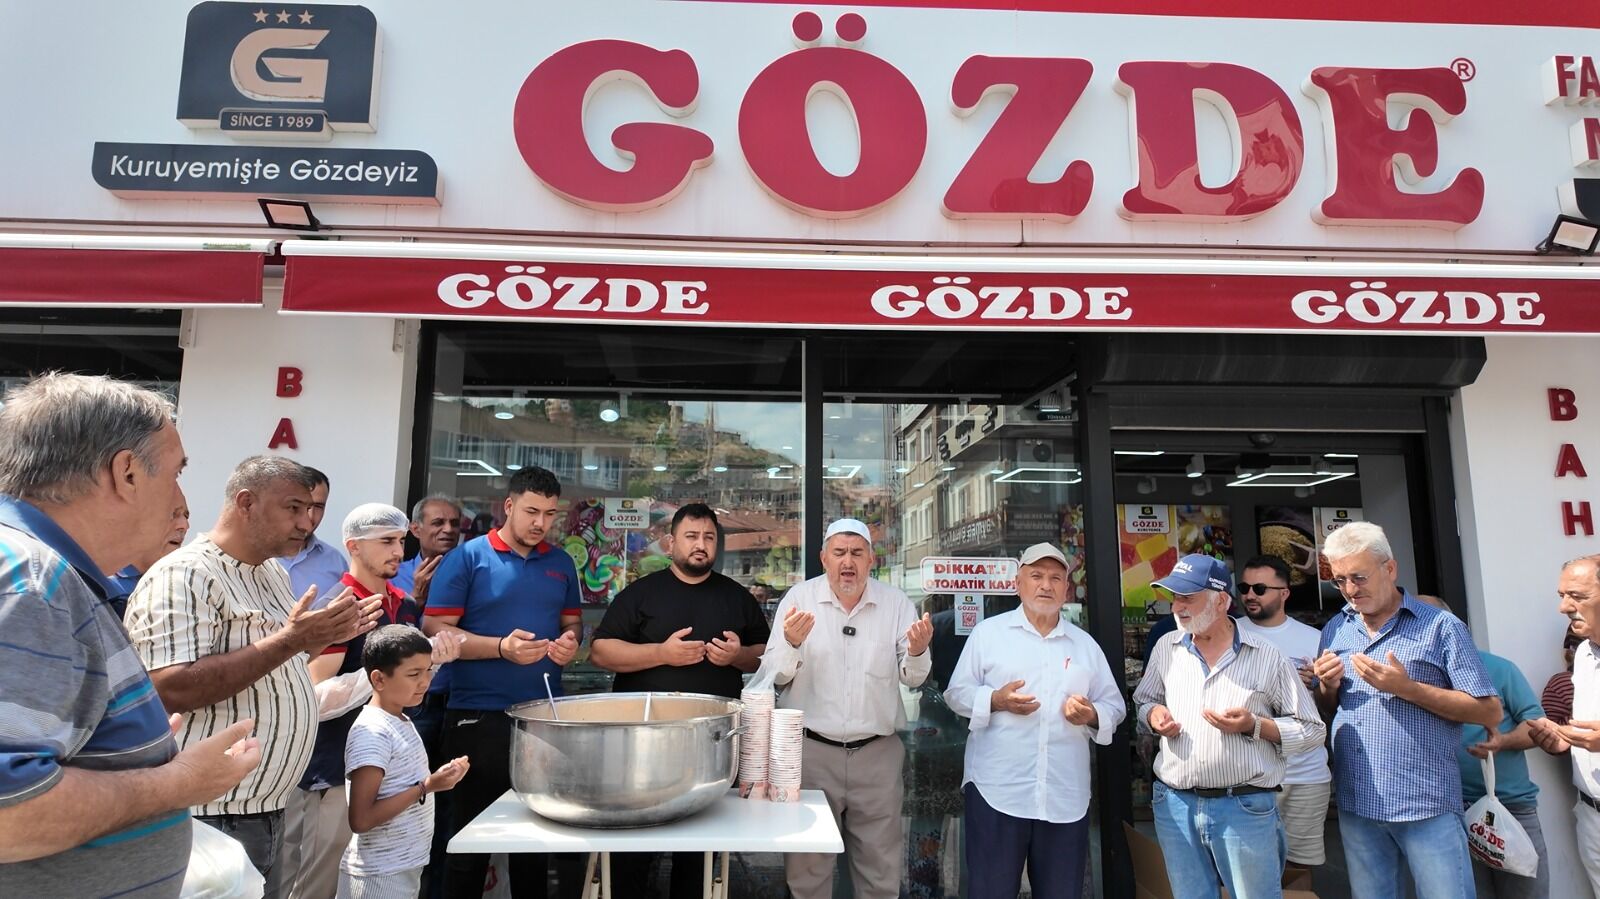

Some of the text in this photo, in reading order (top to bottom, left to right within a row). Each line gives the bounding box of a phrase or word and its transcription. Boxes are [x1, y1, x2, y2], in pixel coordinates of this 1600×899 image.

[277, 115, 314, 129] 1989
[512, 11, 1486, 228] GÖZDE
[110, 154, 419, 186] Kuruyemişte Gözdeyiz
[437, 265, 709, 314] GÖZDE
[871, 276, 1133, 321] GÖZDE
[1291, 281, 1546, 326] GÖZDE
[1132, 520, 1165, 528] GÖZDE
